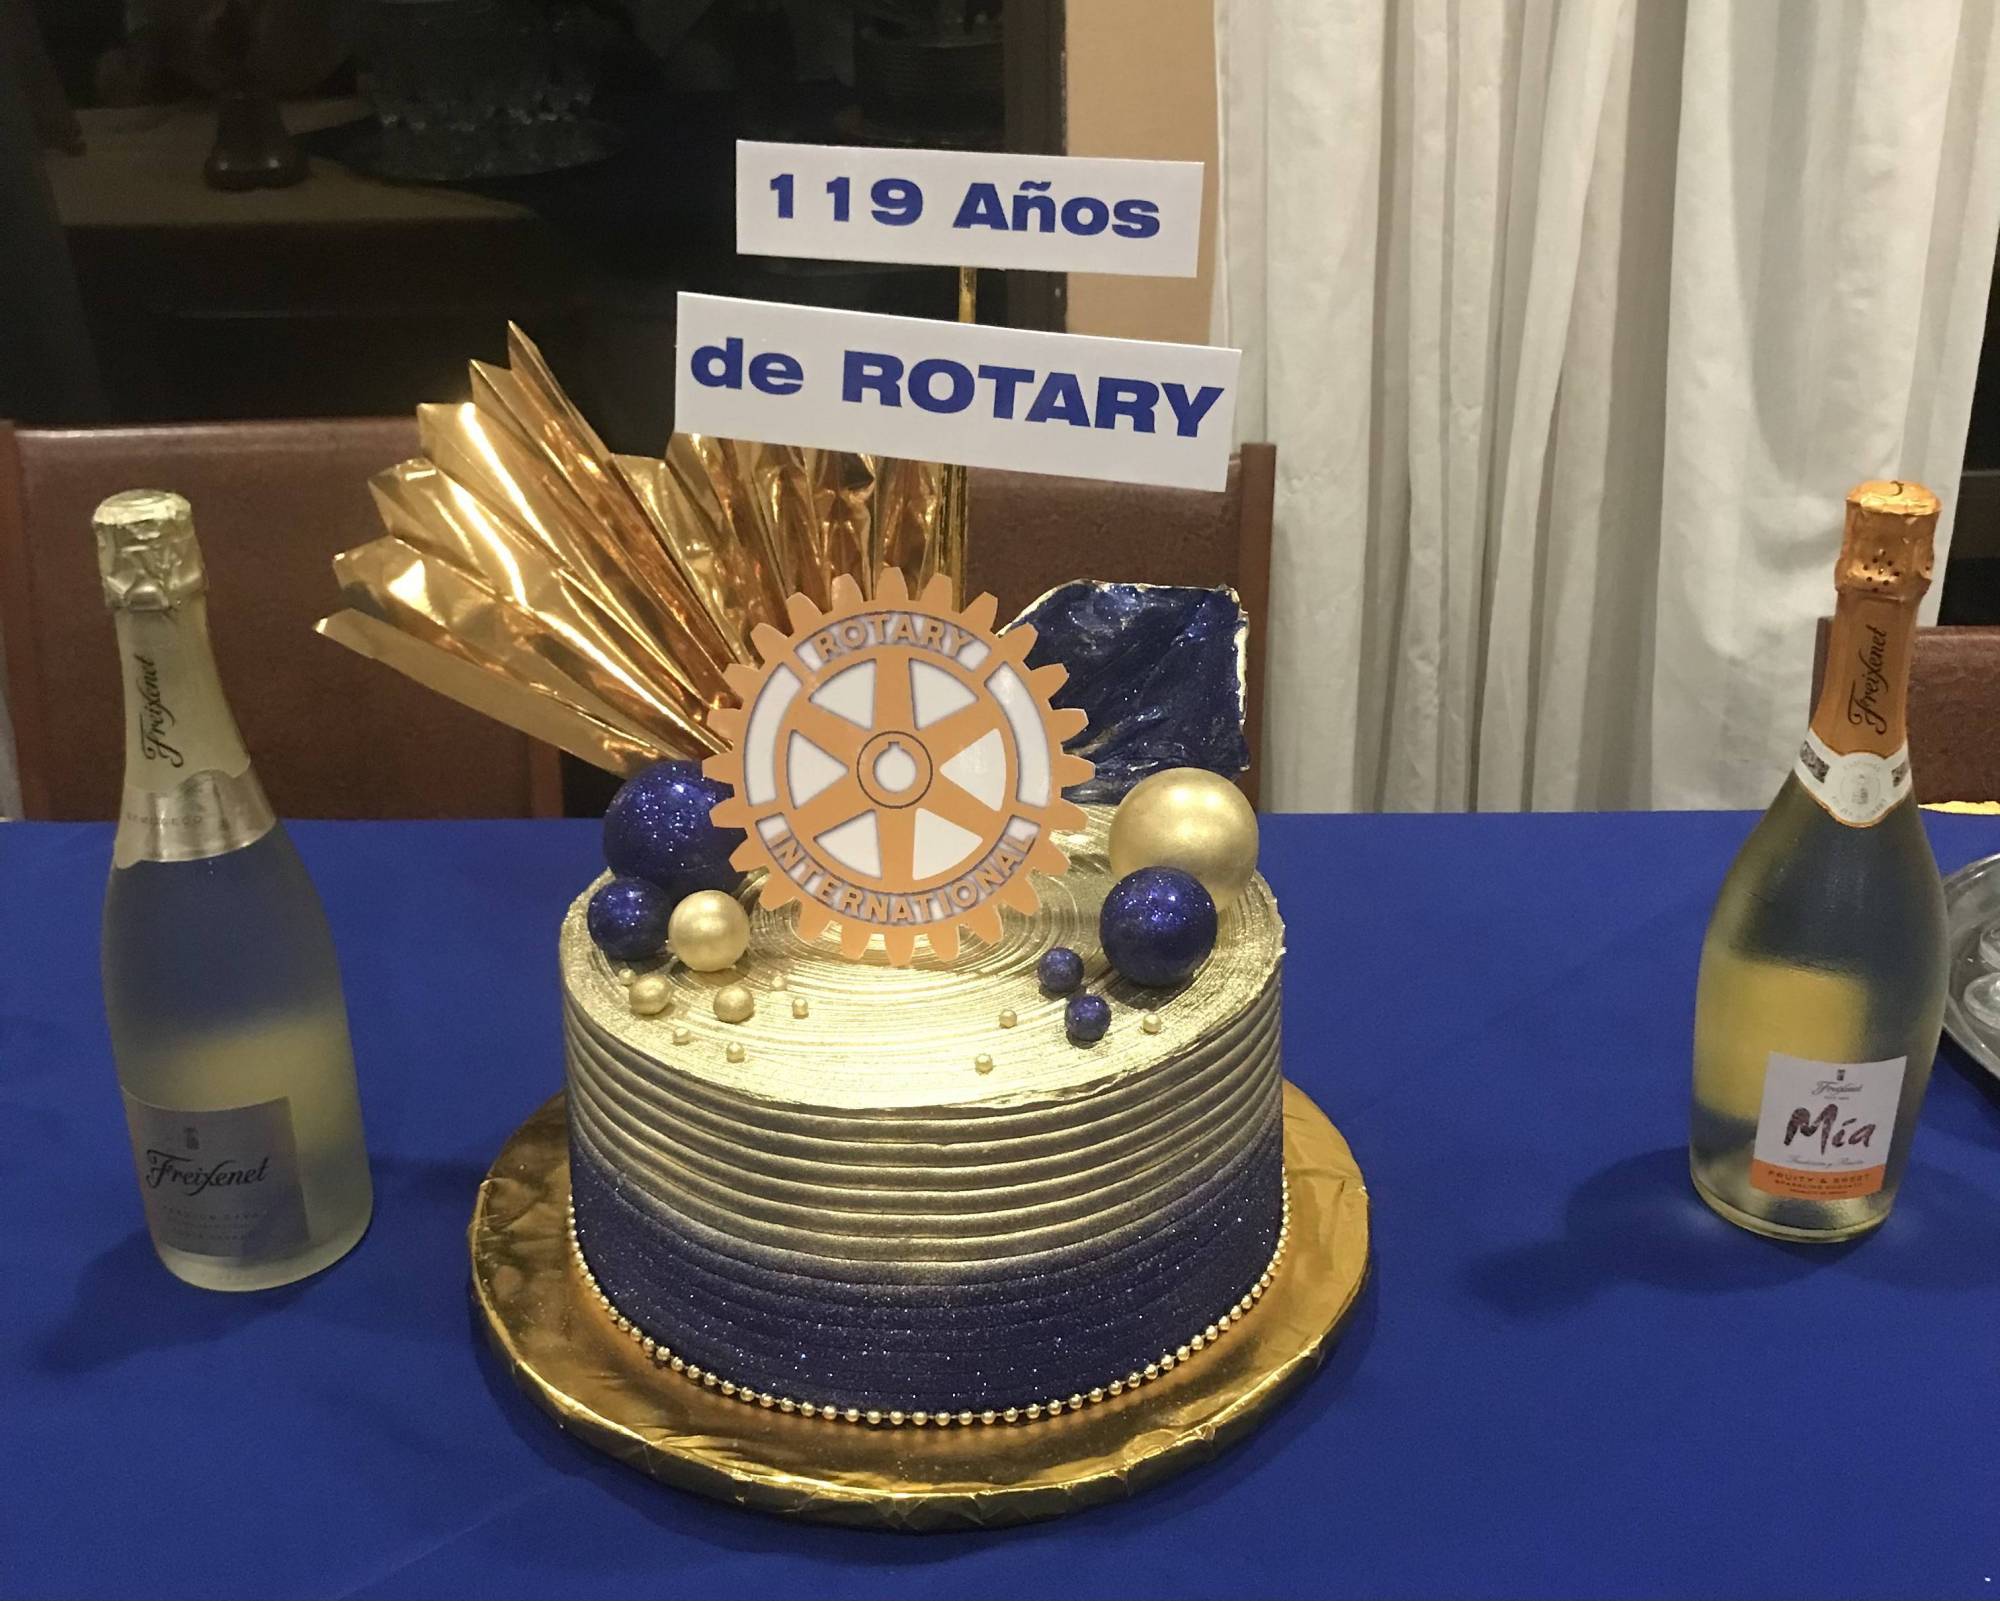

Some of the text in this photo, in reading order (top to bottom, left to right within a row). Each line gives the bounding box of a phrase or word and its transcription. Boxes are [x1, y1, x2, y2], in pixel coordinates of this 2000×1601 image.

[952, 181, 1161, 239] Años
[690, 337, 1225, 438] de ROTARY
[814, 614, 978, 662] ROTARY
[134, 652, 184, 768] Freixenet
[1848, 624, 1888, 735] Freixenet
[766, 830, 1037, 923] INTERNATIONAL
[1783, 1103, 1876, 1155] Mía
[146, 1149, 270, 1197] Freixenet
